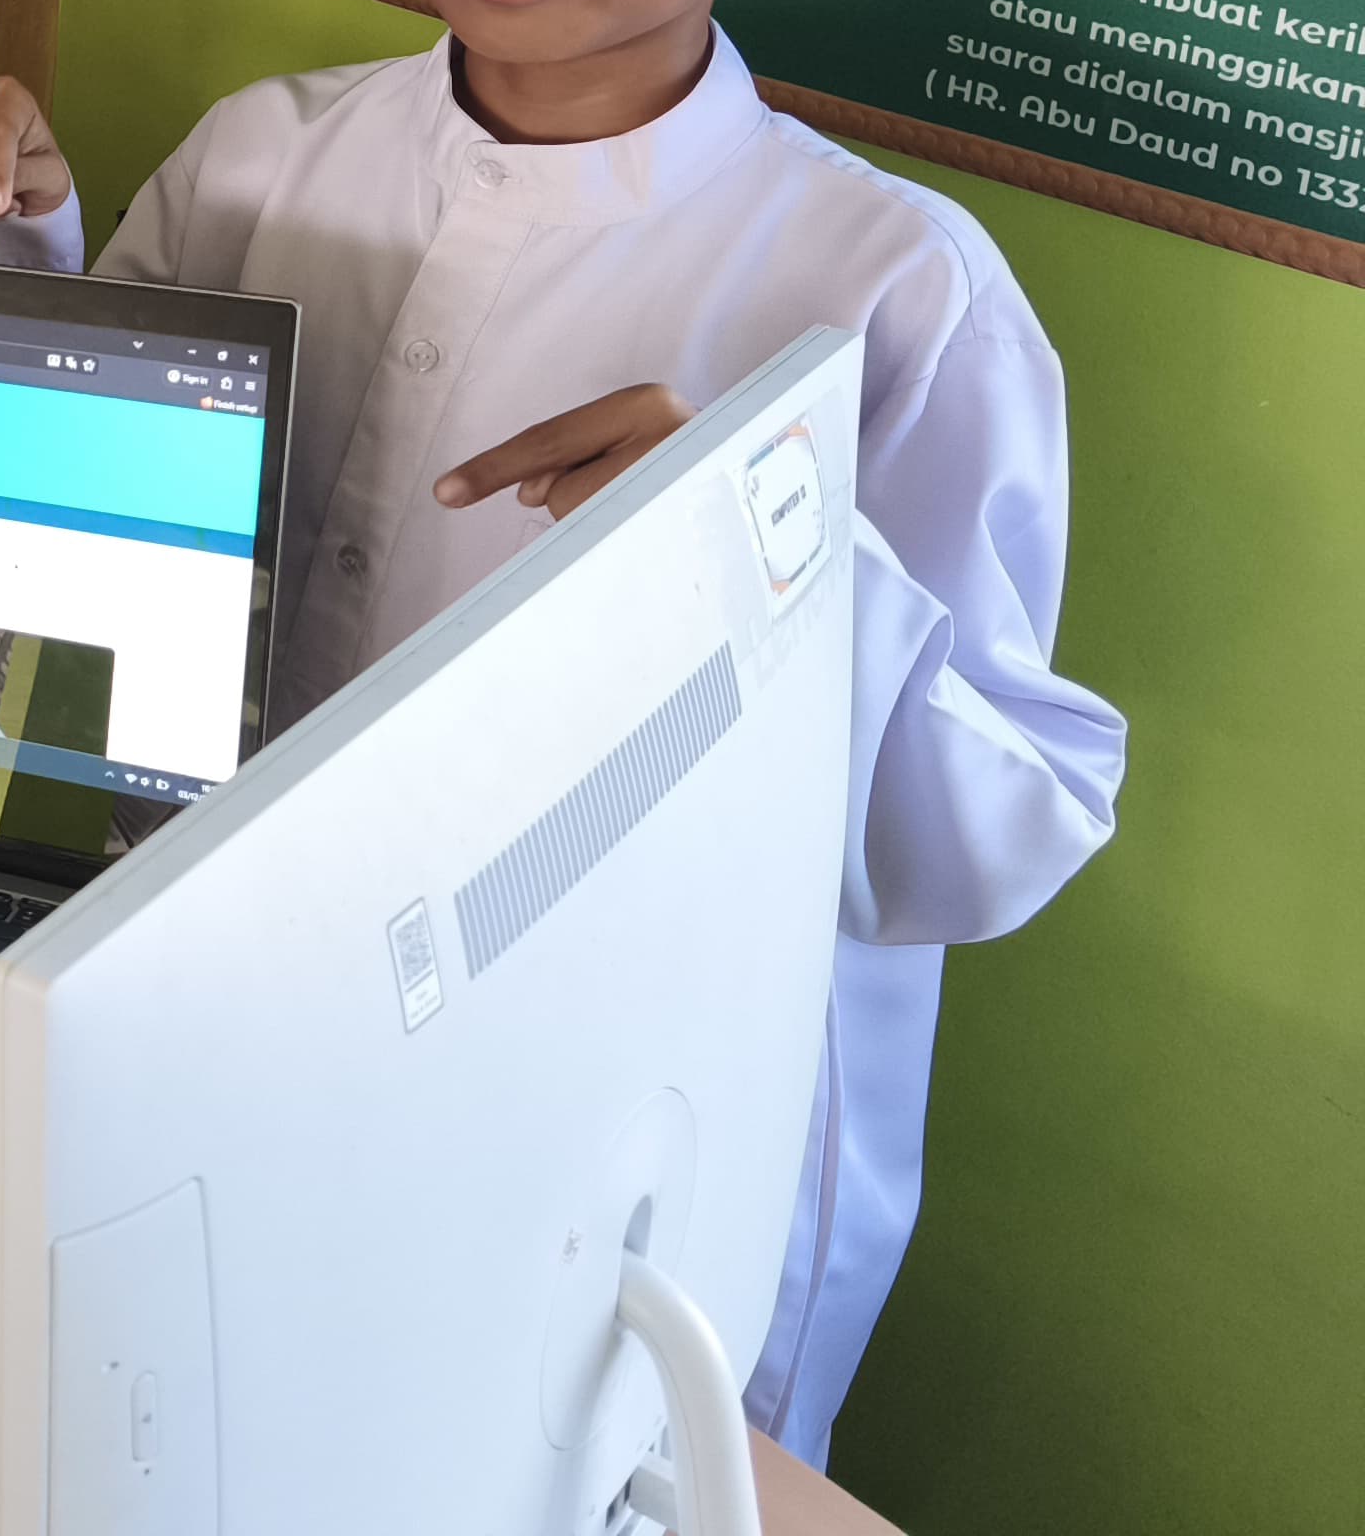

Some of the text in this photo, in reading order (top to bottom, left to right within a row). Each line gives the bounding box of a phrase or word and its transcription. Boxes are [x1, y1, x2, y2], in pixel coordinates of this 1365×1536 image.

[946, 34, 1365, 161] suara didalam masji
[1090, 21, 1365, 106] meninggikan
[1019, 95, 1096, 136] Abu
[1109, 117, 1219, 170] Daud
[1230, 156, 1283, 186] no
